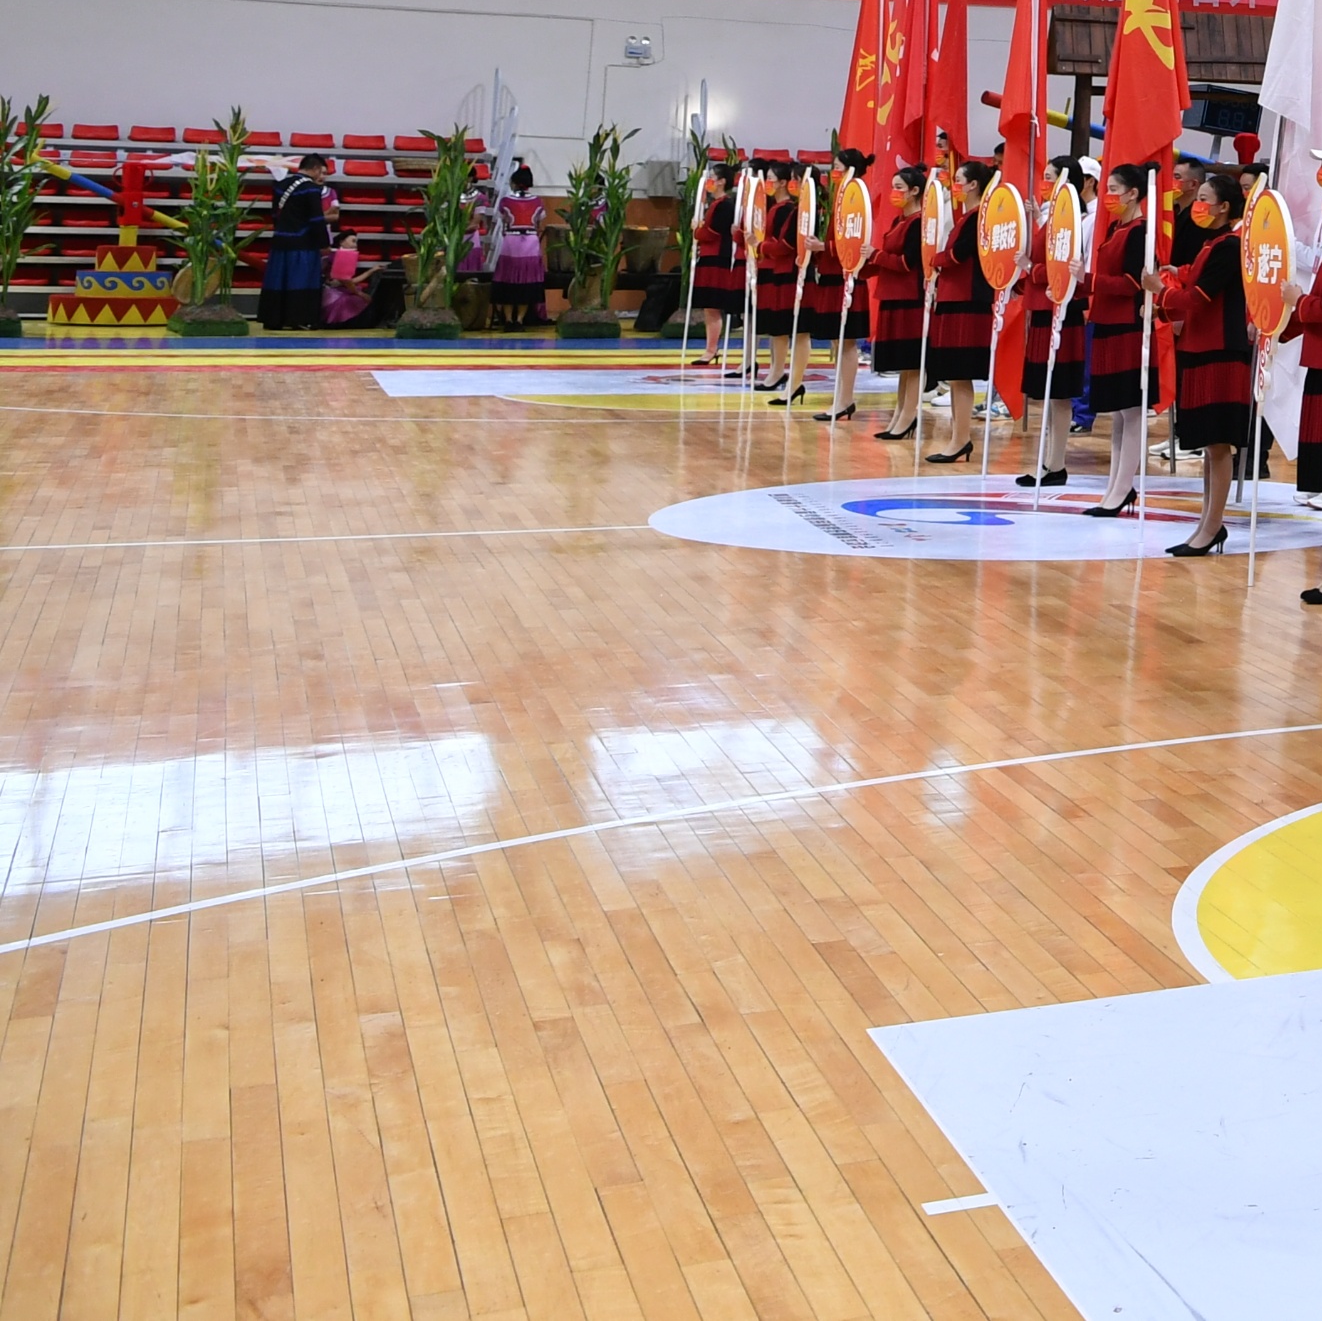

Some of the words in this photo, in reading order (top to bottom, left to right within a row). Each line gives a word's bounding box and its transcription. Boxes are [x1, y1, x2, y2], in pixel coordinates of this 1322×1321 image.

[845, 212, 863, 240] 乐山
[991, 220, 1017, 253] 攀枝花
[1256, 243, 1283, 285] 遂宁
